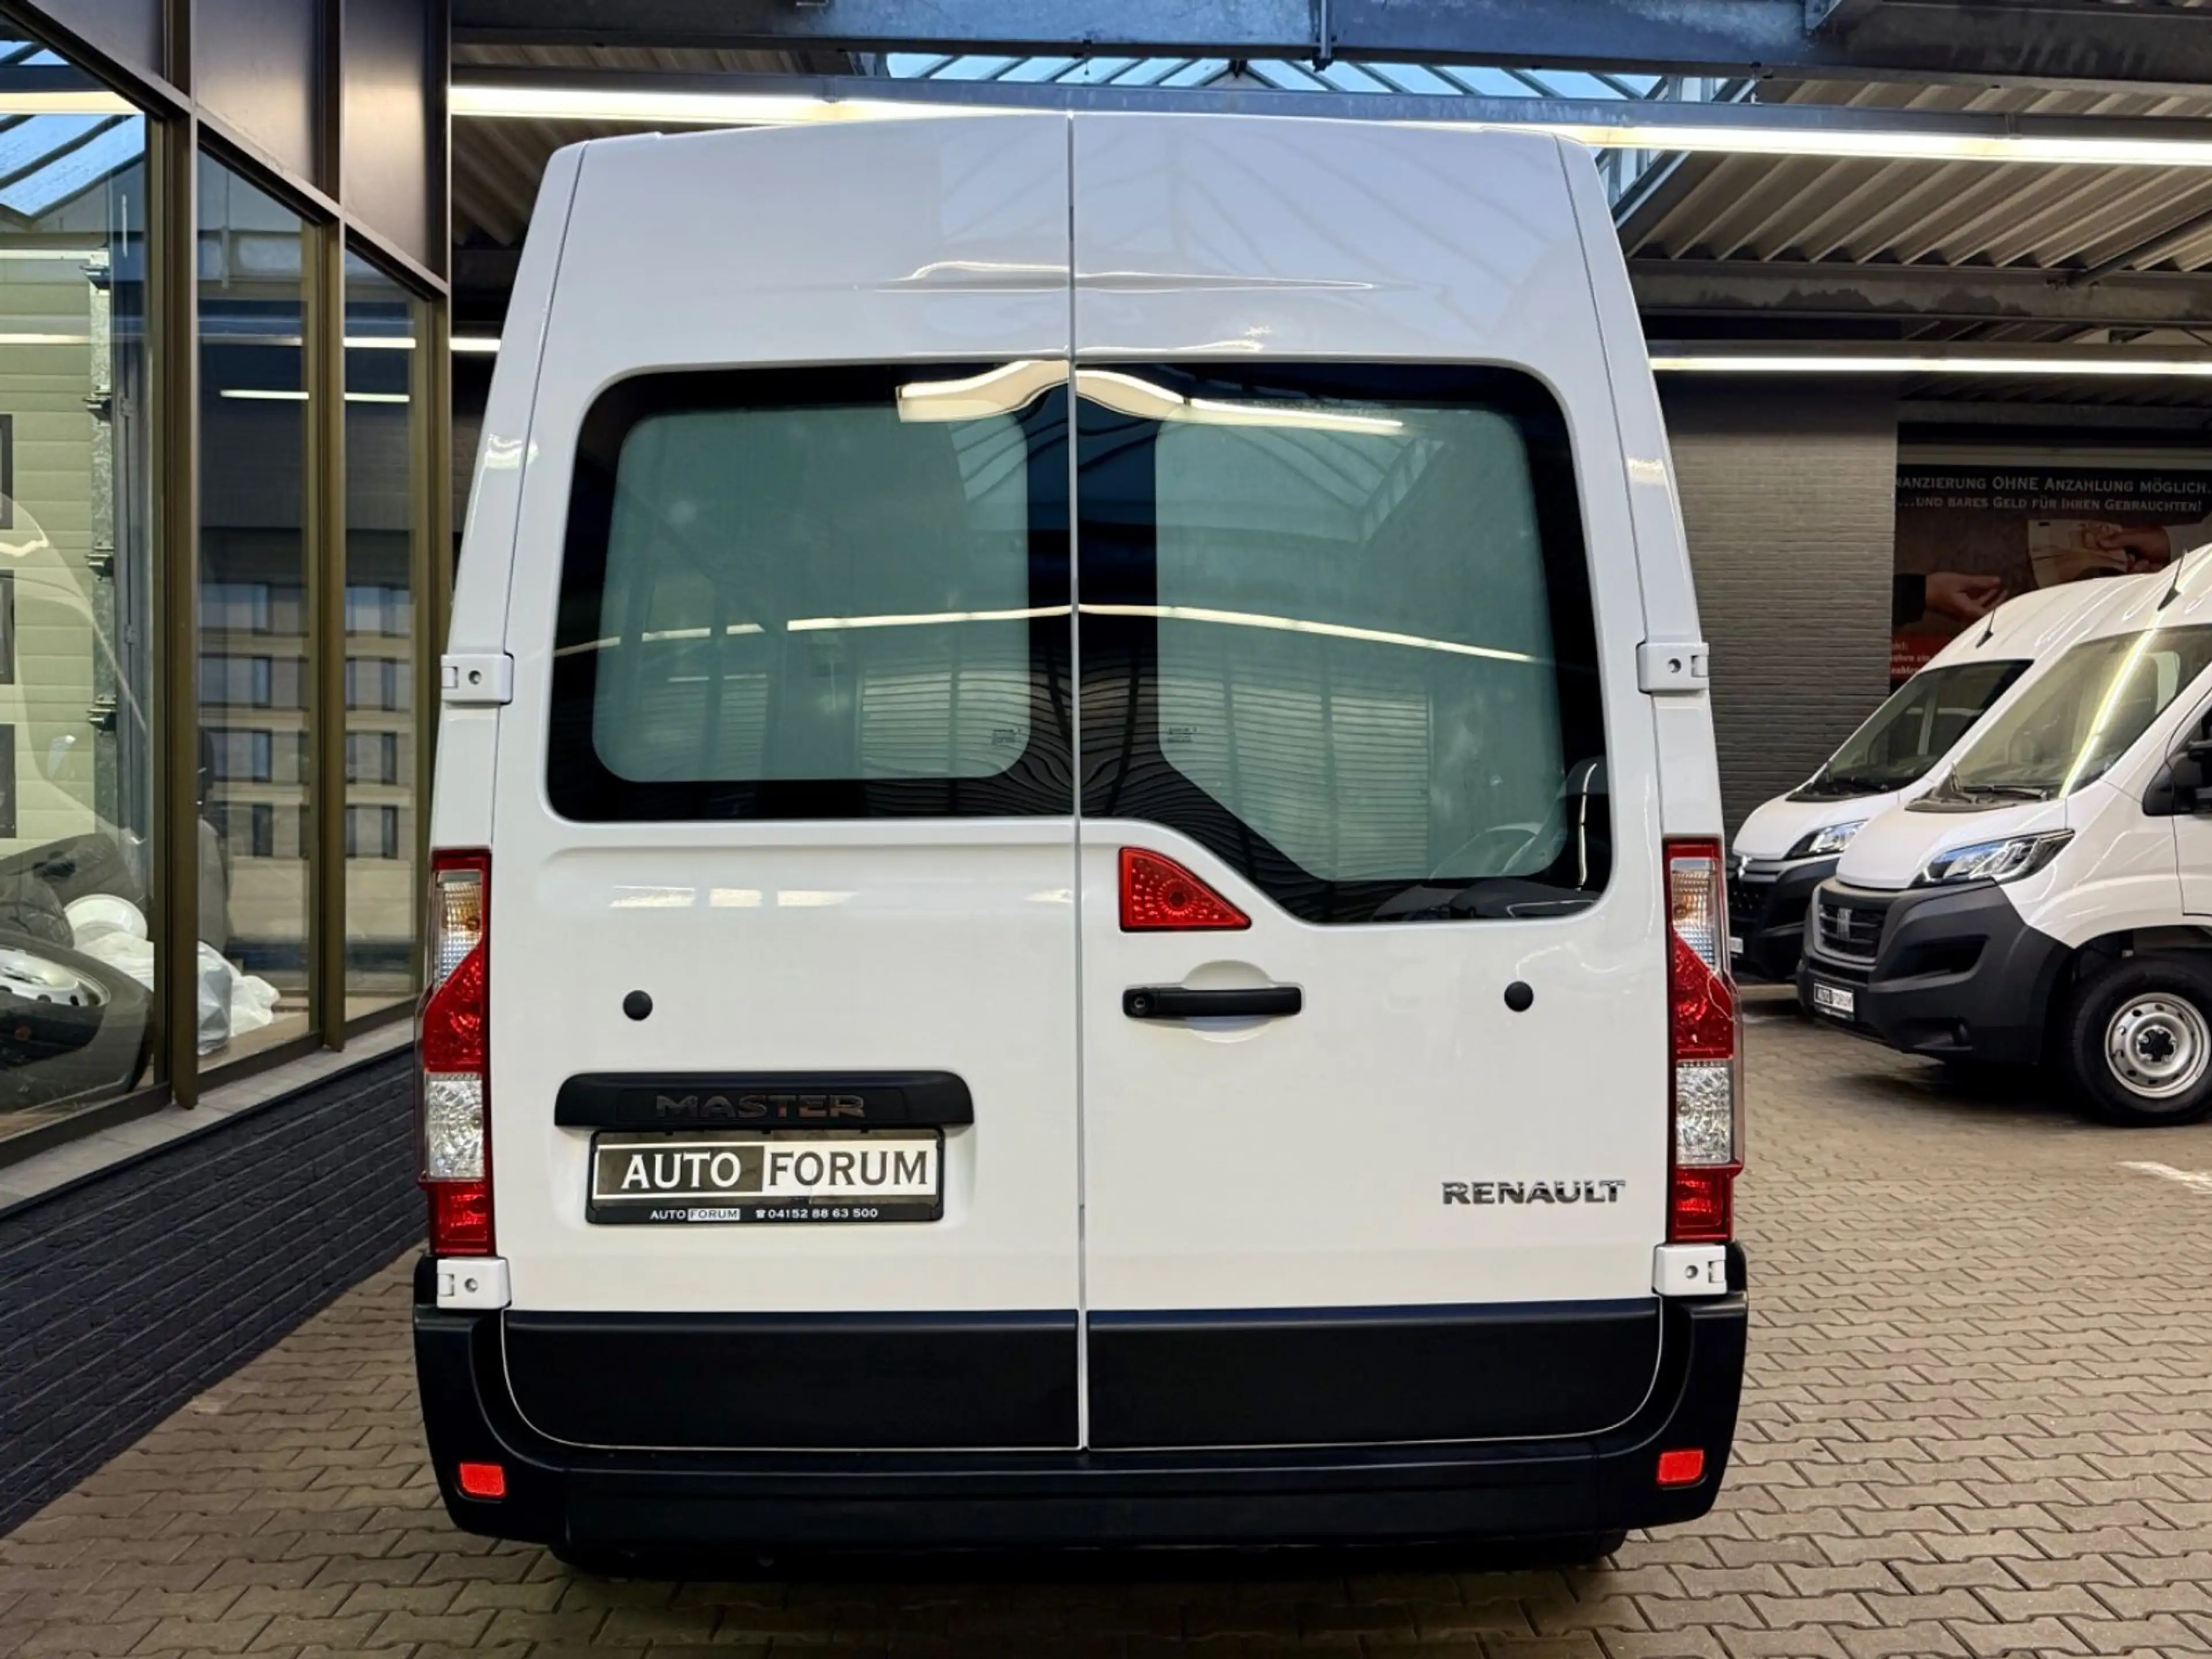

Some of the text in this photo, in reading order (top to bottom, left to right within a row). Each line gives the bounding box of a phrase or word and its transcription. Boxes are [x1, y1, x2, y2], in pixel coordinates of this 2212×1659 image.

[1992, 475, 2040, 490] OHNE
[2044, 477, 2134, 493] ANZAHLUNG
[1947, 497, 1989, 508] BARES
[1993, 496, 2028, 508] GELD
[2032, 494, 2057, 509] FÜR
[2061, 497, 2100, 510] IHREN
[2104, 498, 2202, 513] GEBRAUCHTEN!
[657, 1094, 865, 1118] MASTER
[620, 1151, 928, 1189] AUTO FORUM
[1441, 1180, 1626, 1205] RENAULT
[650, 1209, 738, 1220] AUTO FORUM
[812, 1209, 829, 1218] 88
[832, 1209, 849, 1218] 63
[853, 1208, 878, 1218] 500
